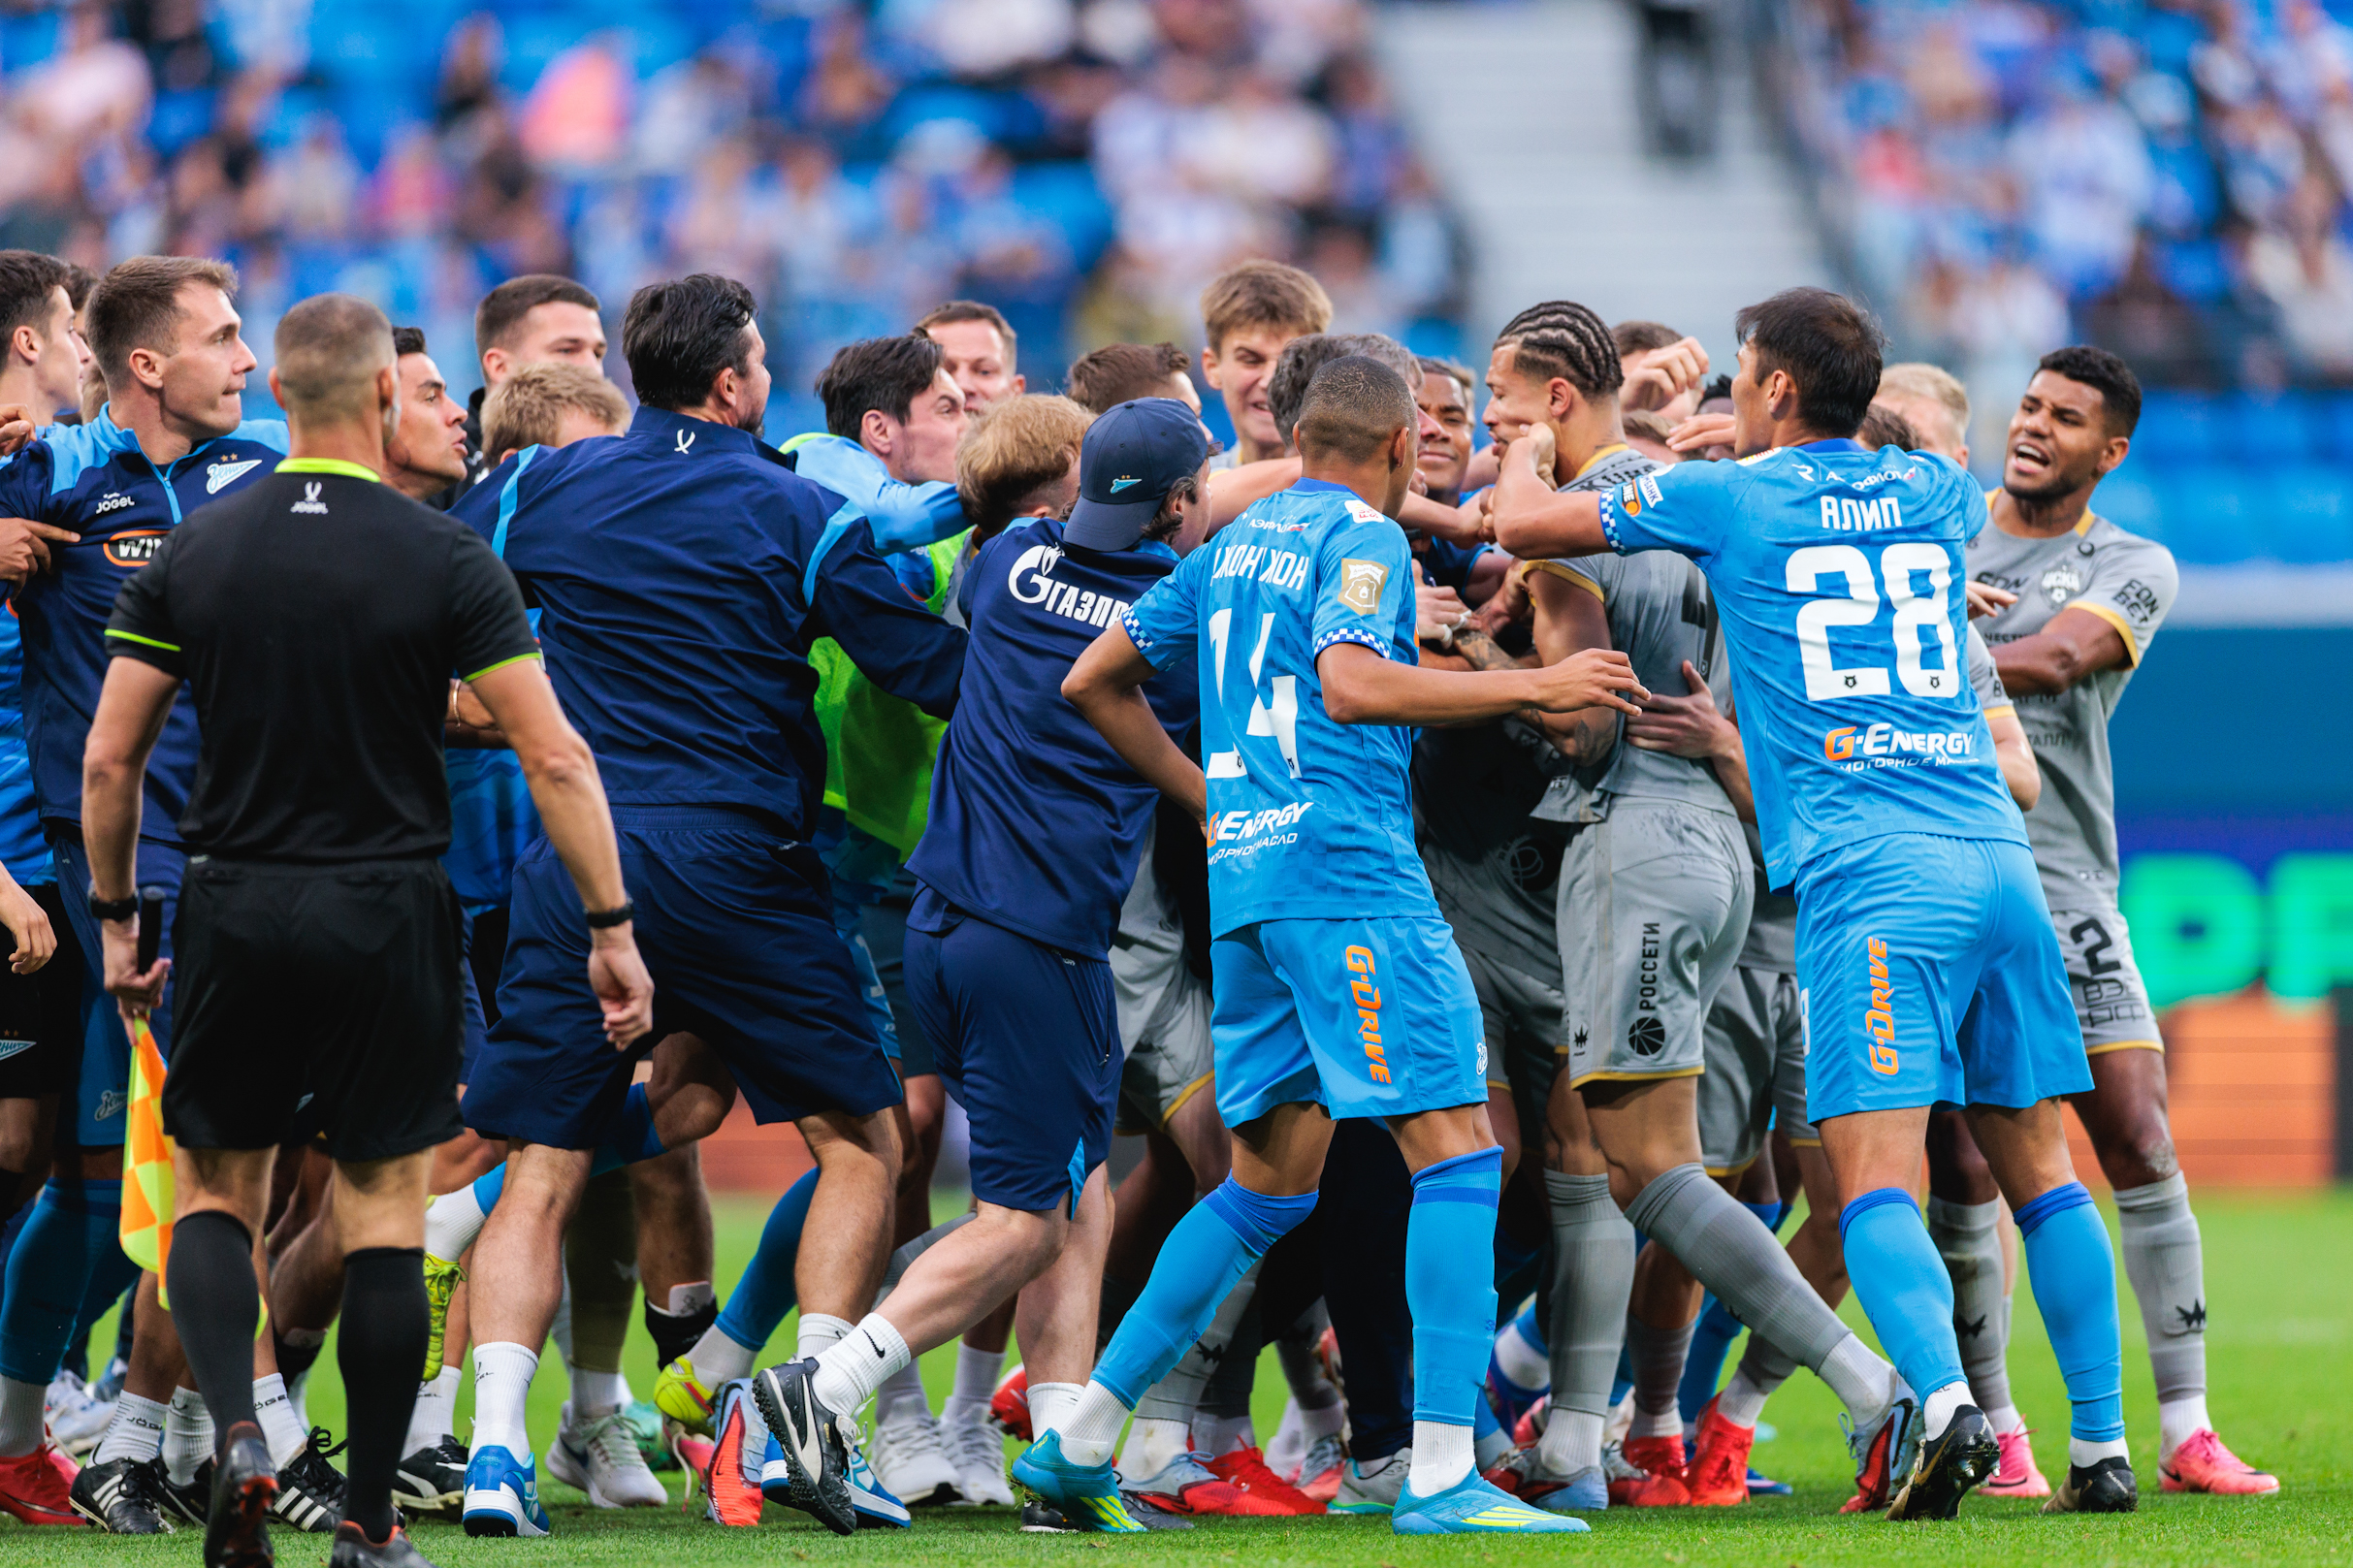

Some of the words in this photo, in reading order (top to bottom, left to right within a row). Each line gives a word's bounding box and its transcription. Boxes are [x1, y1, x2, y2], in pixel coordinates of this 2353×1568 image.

[1821, 496, 1903, 531] АЛИП
[1045, 581, 1129, 630] ГАЗПР
[1786, 543, 1959, 701] 28
[1206, 608, 1303, 779] 14
[1639, 922, 1660, 1010] РОССЕТИ
[2070, 916, 2122, 976] 2
